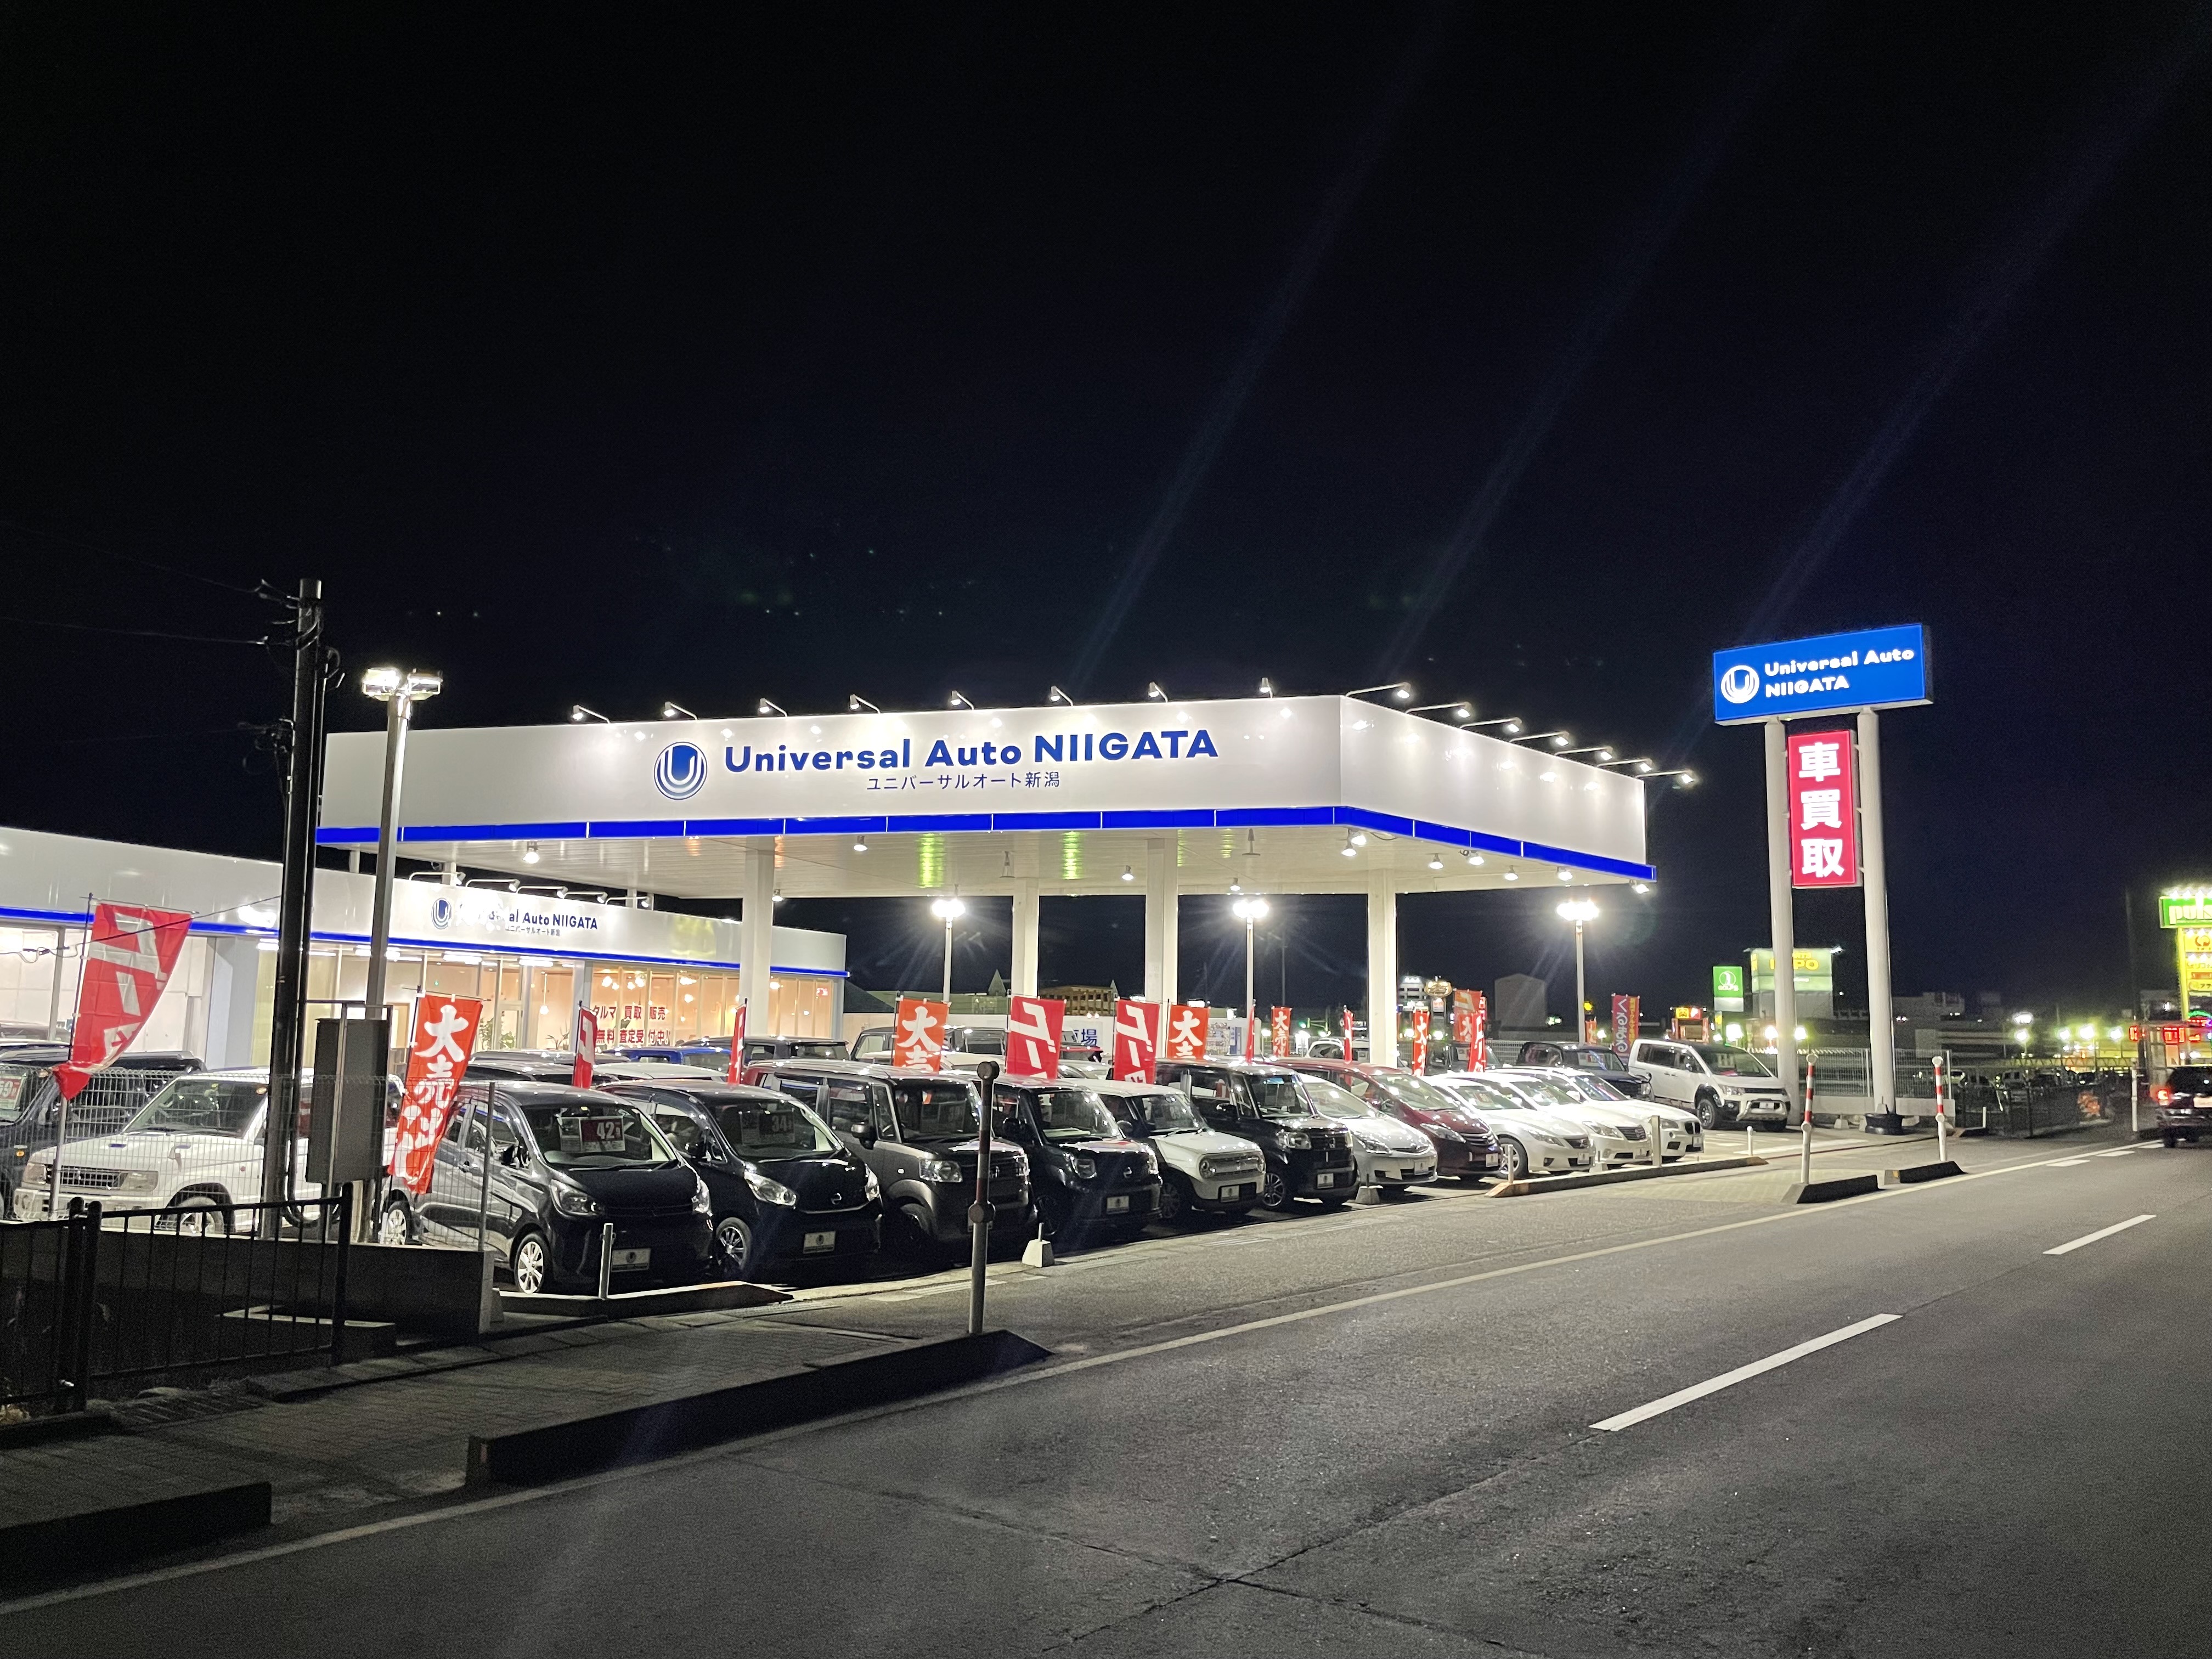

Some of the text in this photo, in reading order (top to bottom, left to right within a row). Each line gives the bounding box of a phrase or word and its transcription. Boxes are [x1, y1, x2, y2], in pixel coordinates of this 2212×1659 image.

[1764, 648, 1914, 676] Universal Auto
[1765, 675, 1849, 698] NIIGATA
[725, 729, 1218, 774] Universal Auto NIIGATA
[866, 771, 1060, 791] ユニバーサルオート新潟
[1798, 742, 1845, 878] 車買取
[522, 911, 550, 926] Auto
[552, 913, 598, 930] NIIGATA
[625, 1006, 642, 1019] 買取
[1074, 1029, 1098, 1046] 場
[597, 1121, 615, 1139] 42
